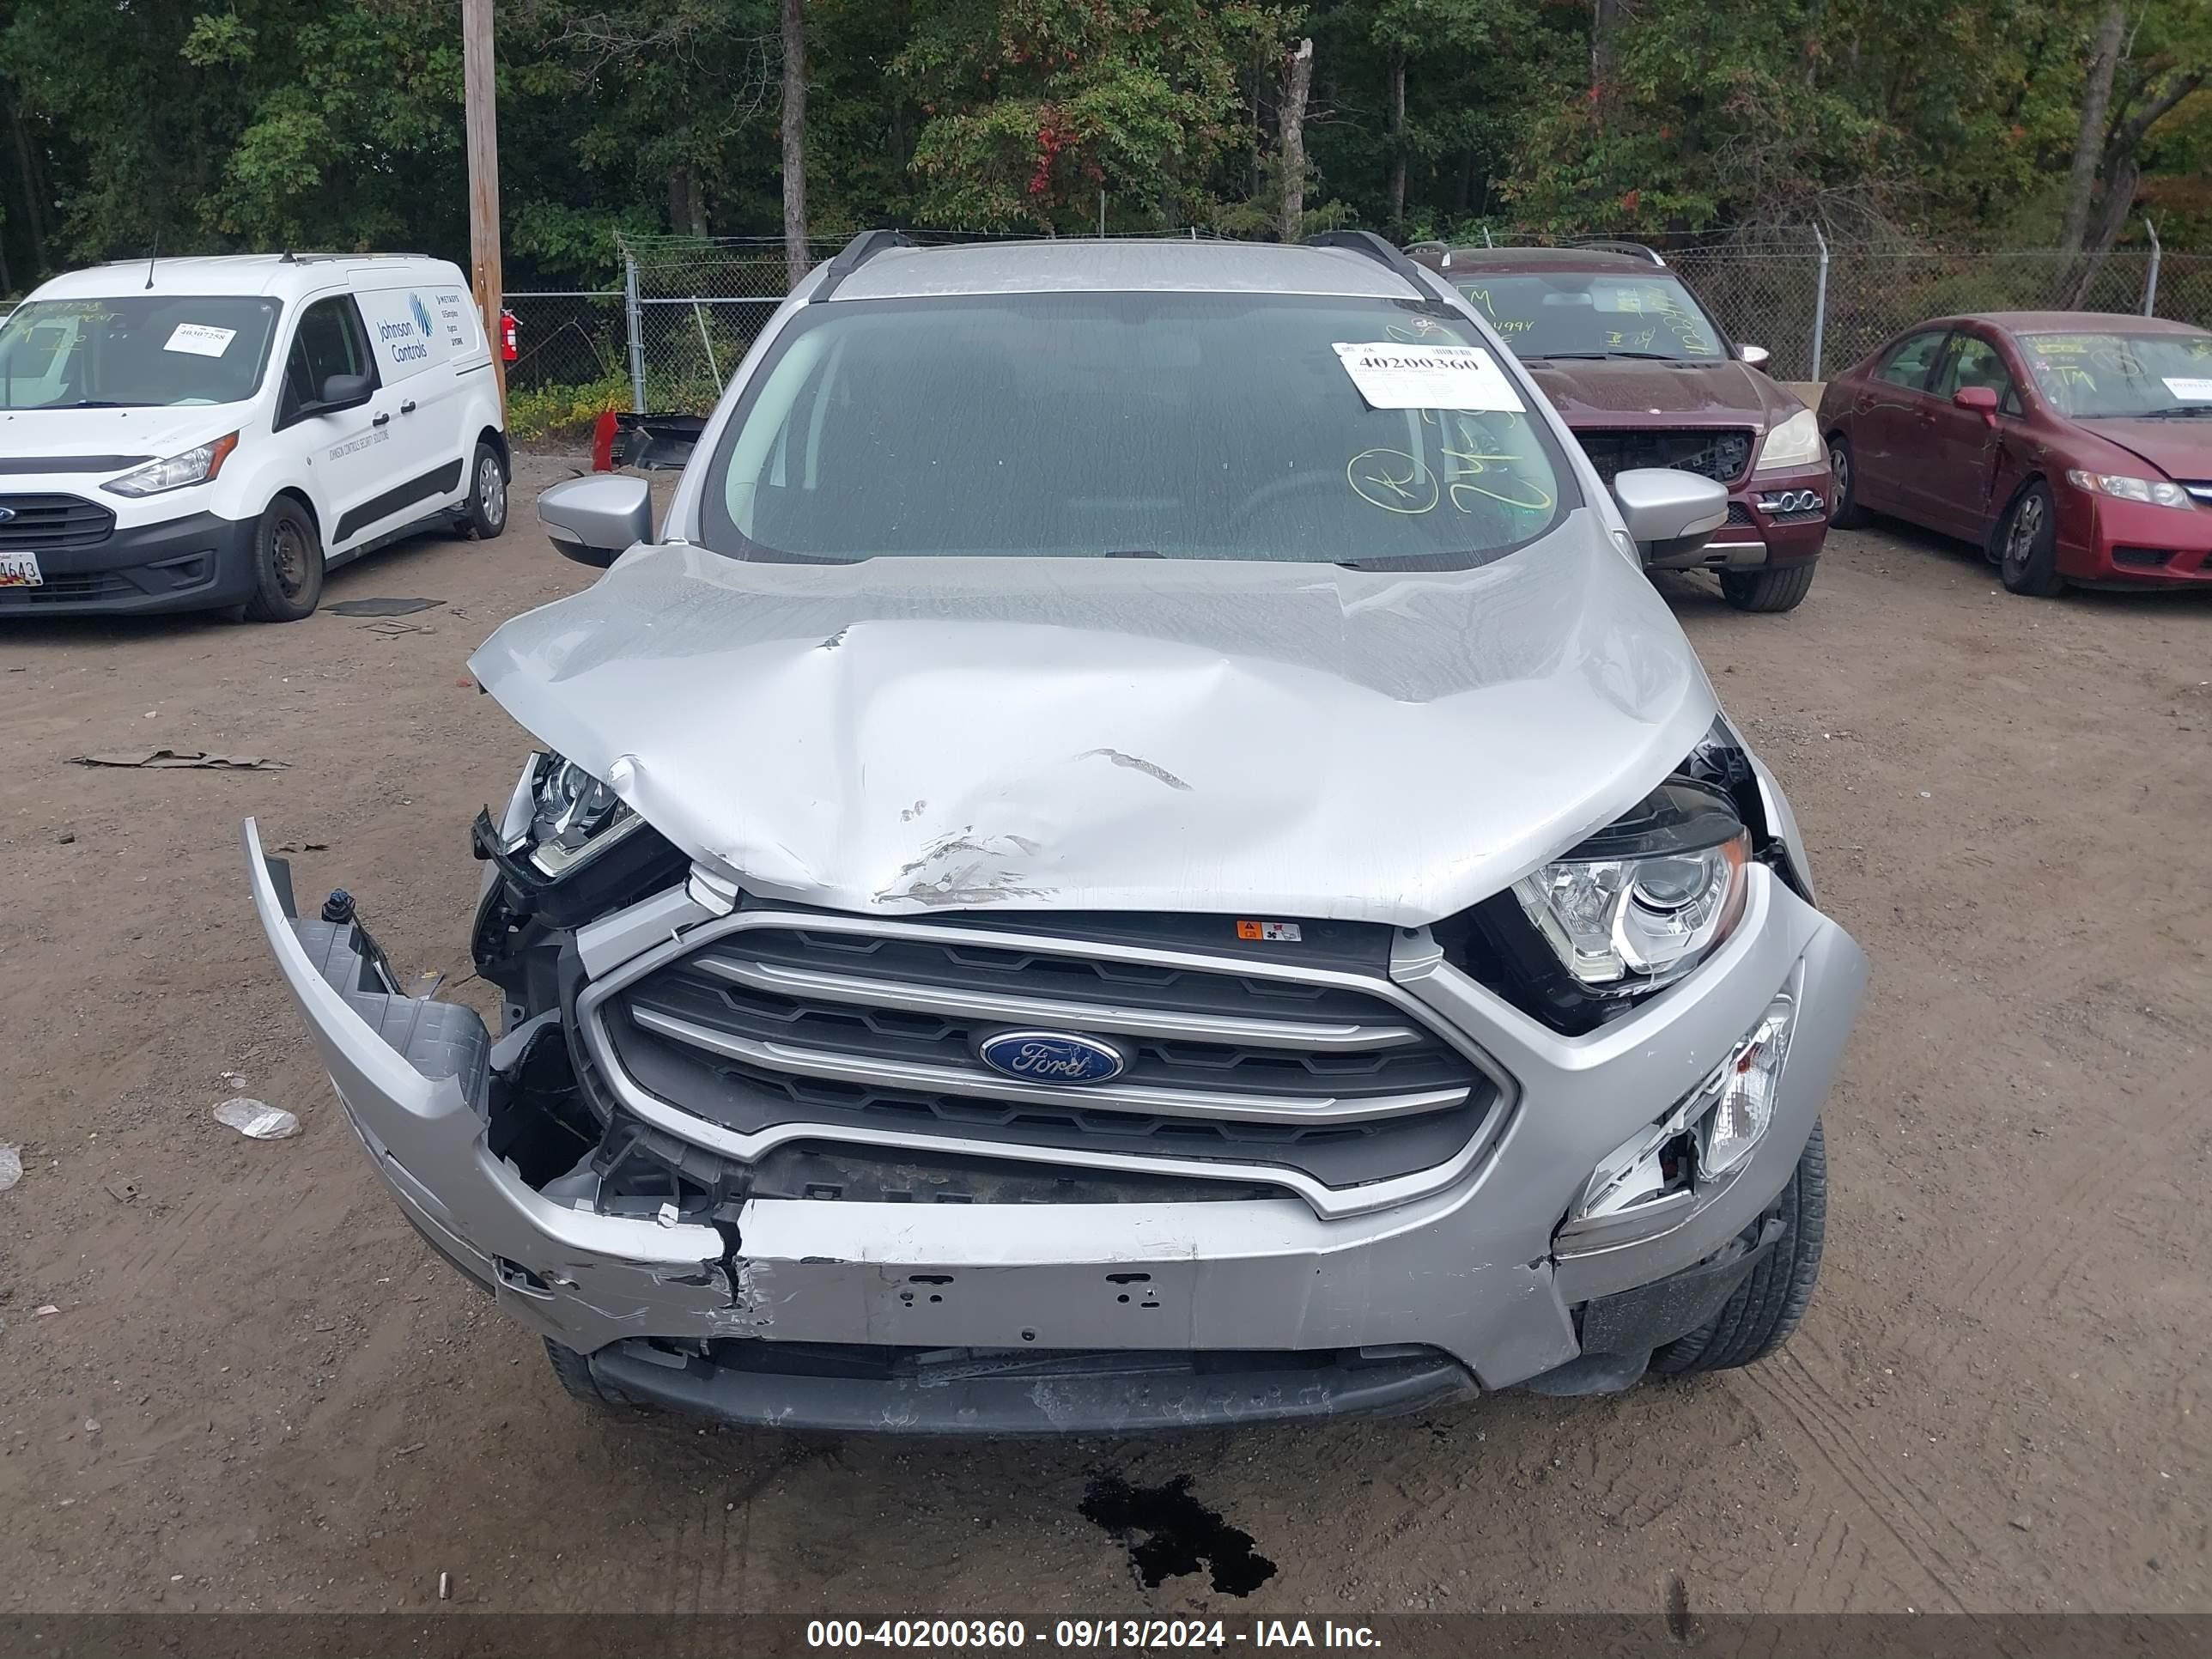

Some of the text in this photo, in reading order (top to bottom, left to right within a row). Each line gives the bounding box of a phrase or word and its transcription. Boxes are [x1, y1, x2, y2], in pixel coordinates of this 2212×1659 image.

[376, 319, 414, 343] Johnson
[392, 338, 428, 362] Controls
[1359, 356, 1479, 371] 40200360
[1012, 1042, 1091, 1077] Ford
